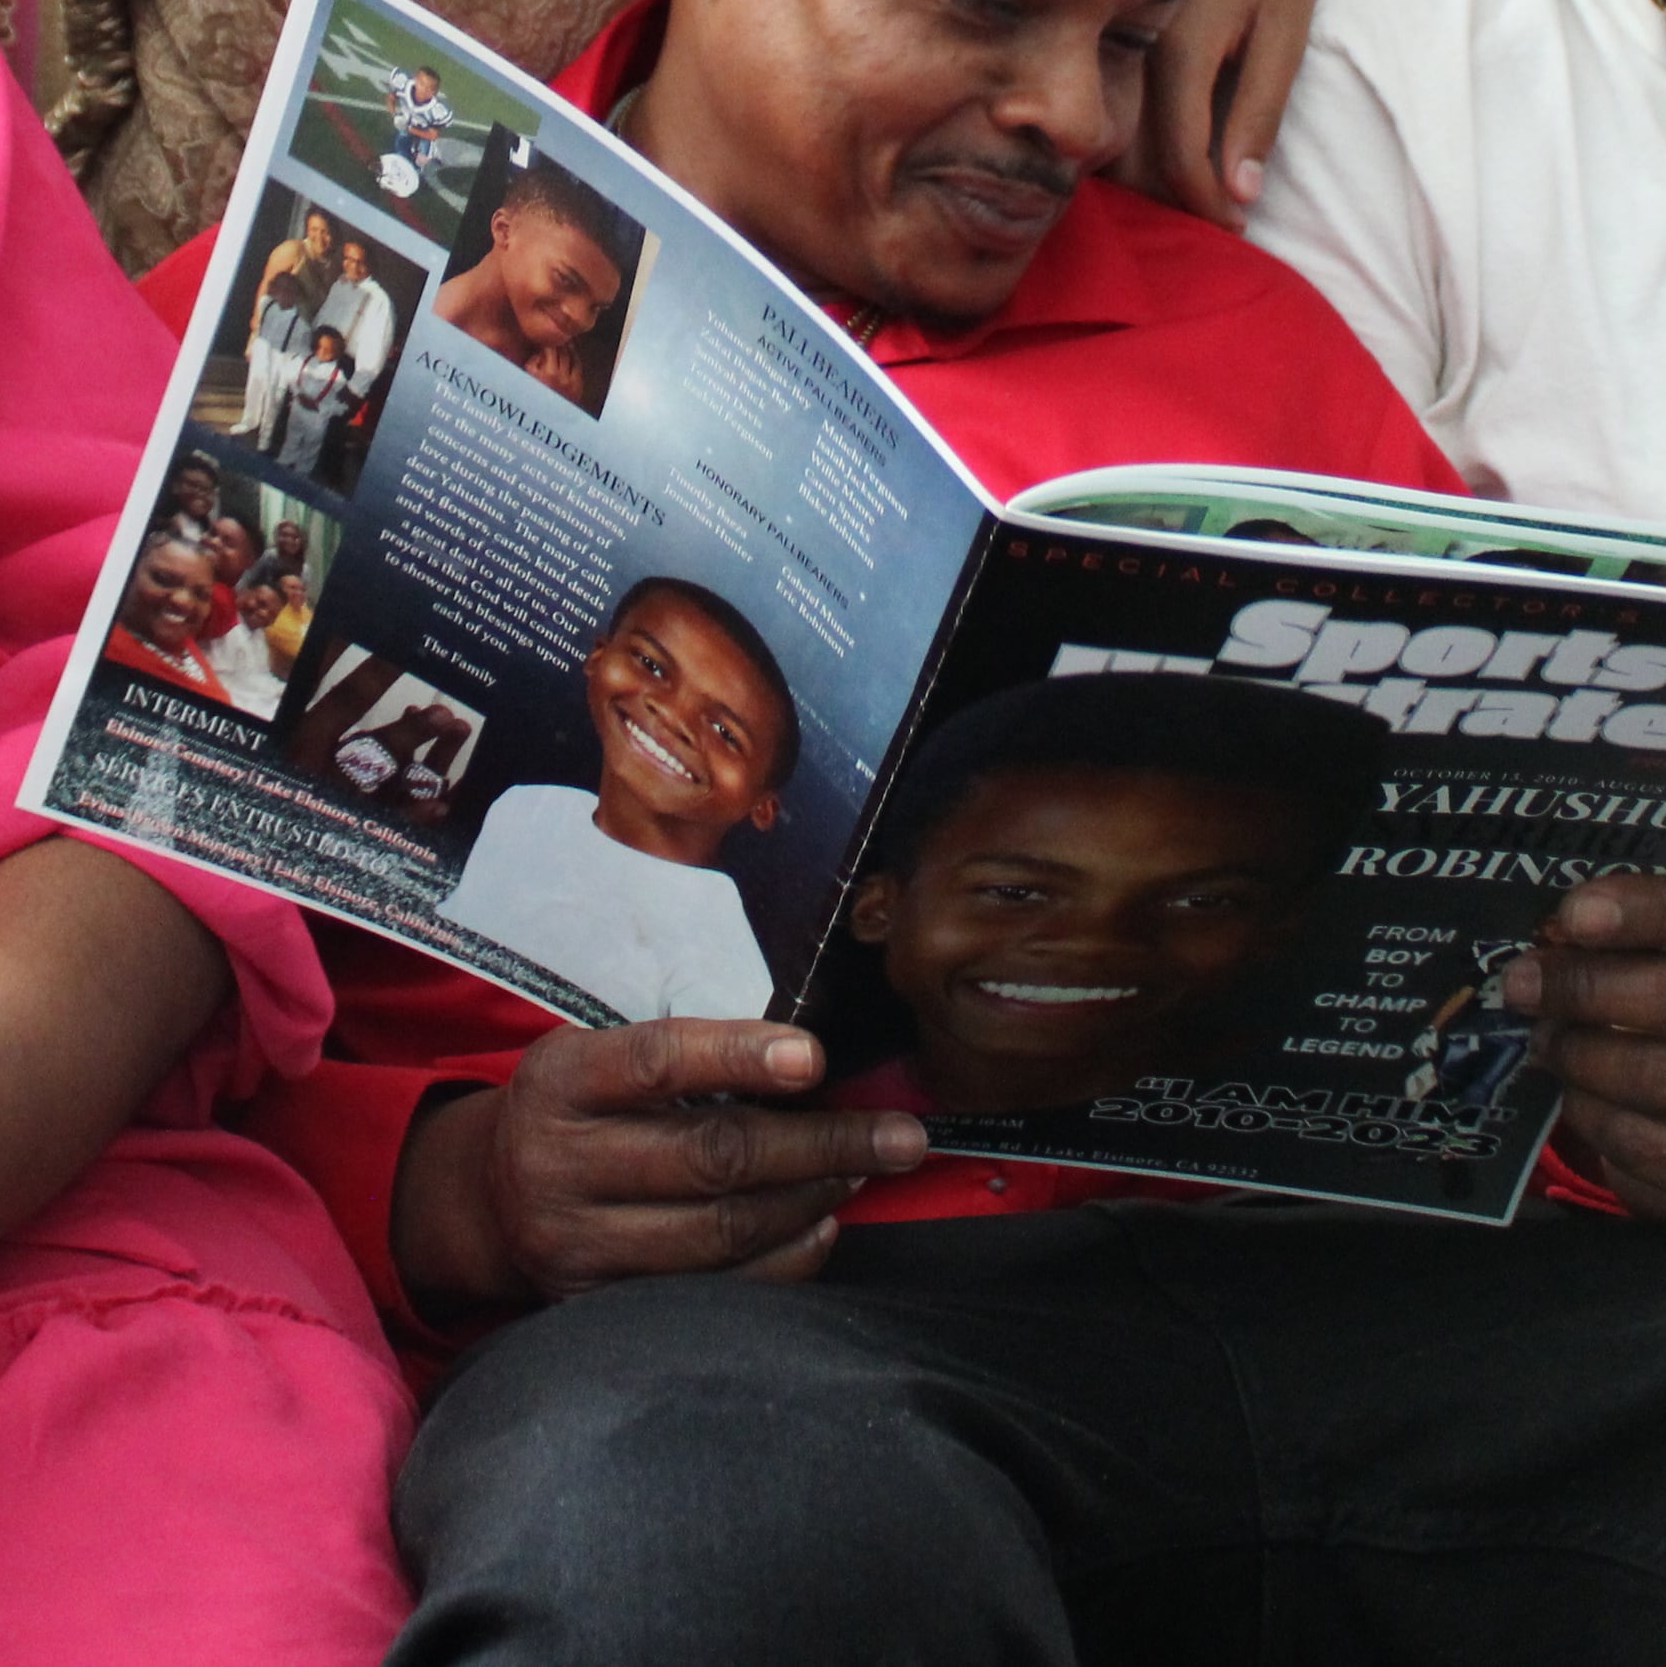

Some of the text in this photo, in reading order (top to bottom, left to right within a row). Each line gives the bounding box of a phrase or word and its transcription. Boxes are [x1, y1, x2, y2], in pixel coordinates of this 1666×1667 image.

[757, 335, 886, 467] ACTIVE PALLBEARERS
[762, 303, 899, 450] PALLBEARERS
[416, 351, 665, 526] ACKNOWLEDGEMENTS
[431, 402, 627, 541] for the many acts of kindness,
[435, 380, 641, 527] The family is extremely grateful
[724, 411, 774, 462] Ferguson
[815, 433, 885, 516] Isaiah Jackson
[822, 419, 909, 521] Malachi Ferguson
[405, 456, 613, 596] dear Yahushua. The many calls,
[419, 438, 614, 572] love during the passing of our
[427, 425, 613, 550] concerns and expressions of
[664, 483, 753, 563] Jonathan Hunter
[669, 466, 715, 510] Timothy
[798, 481, 875, 570] Blake Robinson
[811, 449, 876, 526] Willie Moore
[837, 501, 871, 543] Sparks
[395, 494, 598, 628] and words of condolence mean
[401, 473, 606, 611] food, flowers, cards, kind deeds
[695, 458, 849, 610] HONORARY PALLBEARERS
[1007, 540, 1236, 588] SPECIAL
[379, 528, 587, 662] prayer is that God will continue
[384, 550, 570, 673] to shower his blessings upon
[401, 519, 581, 635] a great deal to all of us. Our
[782, 565, 820, 609] Gabriel
[432, 601, 464, 625] each
[465, 621, 483, 635] of
[776, 579, 798, 607] Eric
[798, 602, 845, 658] Robinson
[422, 633, 497, 687] The Family
[122, 682, 268, 752] INTERMENT
[104, 717, 173, 751] Elsinore
[172, 743, 248, 783] Cemetery
[256, 772, 293, 799] Lake
[293, 789, 361, 829] Elsinore,
[362, 818, 439, 863] California
[1393, 768, 1492, 781] OCTOBER
[210, 794, 351, 860] ENTRUSTED
[184, 828, 266, 867] Mortuary
[273, 858, 311, 885] Lake
[313, 875, 381, 917] Elsinore,
[1364, 947, 1434, 966] BOY
[1365, 925, 1458, 944] FROM
[1314, 992, 1428, 1014] CHAMP
[1365, 971, 1405, 988] TO
[1281, 1035, 1405, 1060] LEGEND
[1339, 1016, 1378, 1033] TO
[1088, 1096, 1502, 1159] 2010-2023
[1195, 1082, 1334, 1114] AM
[1044, 1144, 1085, 1157] Lake
[1175, 1159, 1200, 1172] CA
